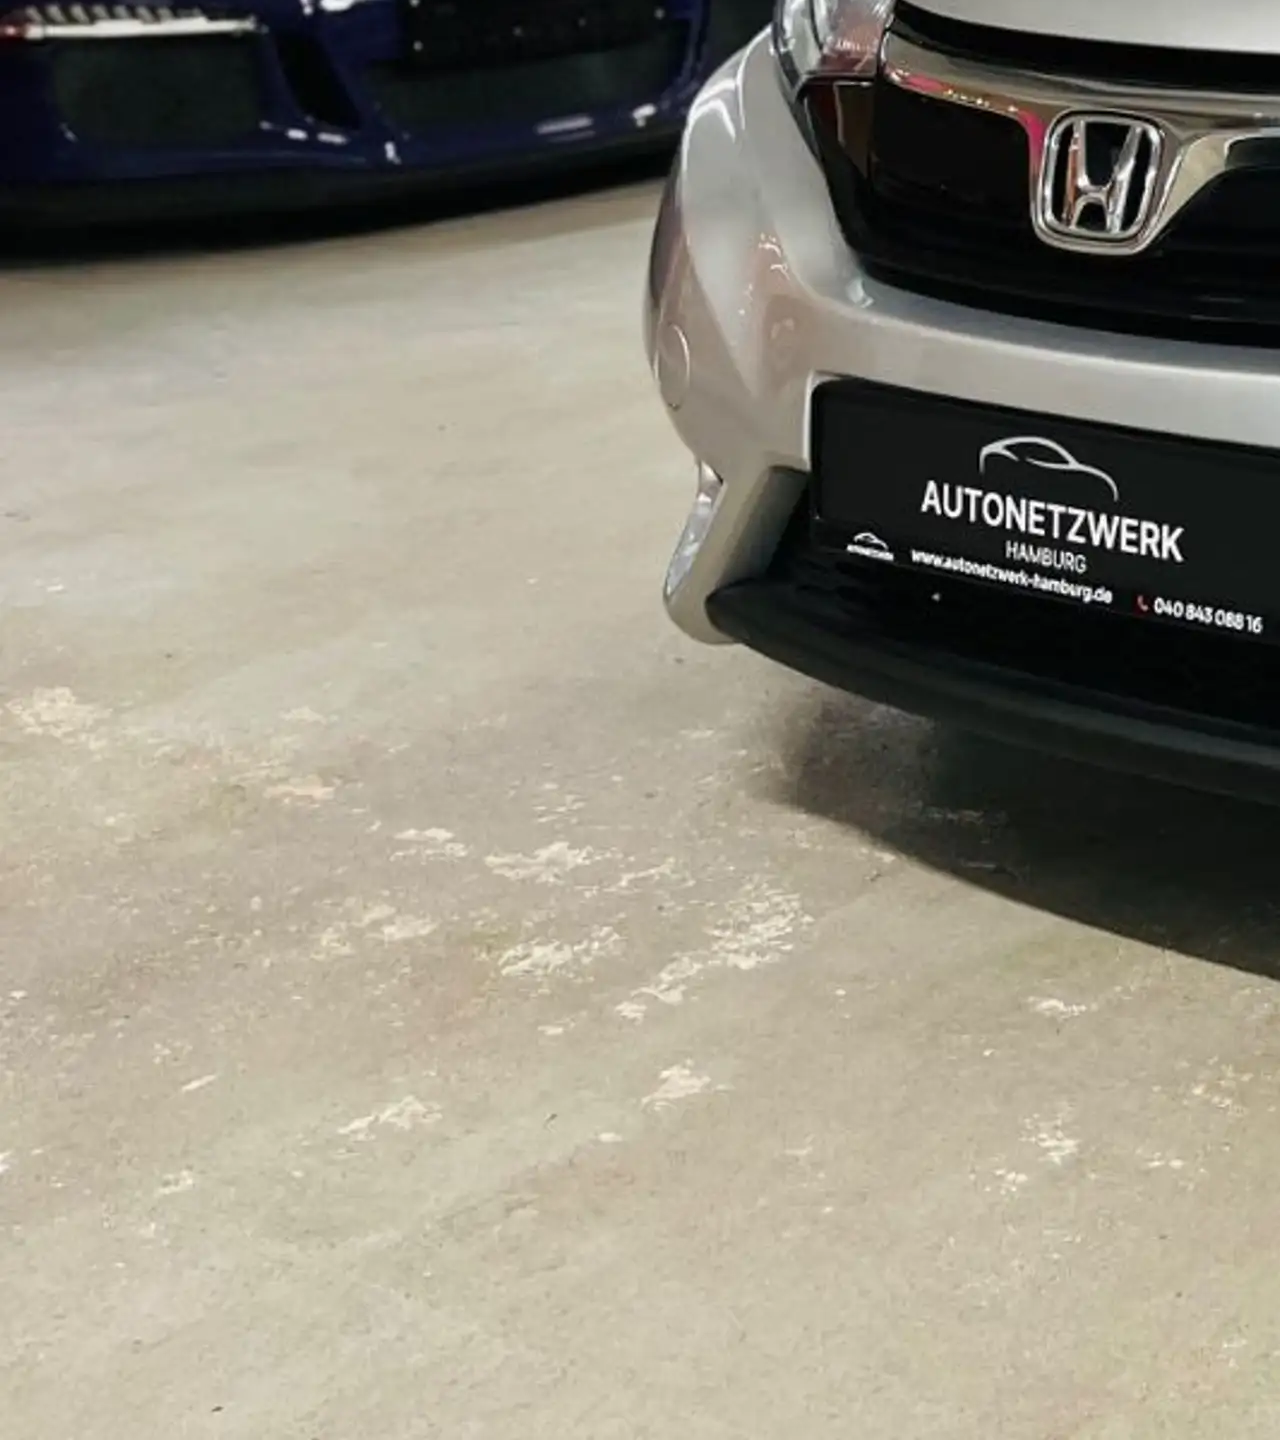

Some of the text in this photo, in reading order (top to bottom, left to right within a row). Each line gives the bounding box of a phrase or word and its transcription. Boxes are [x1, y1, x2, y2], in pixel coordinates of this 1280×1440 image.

[921, 479, 1184, 563] AUTONETZWERK
[1005, 539, 1087, 573] HAMBURG
[911, 549, 1113, 604] www.autonetzwerk-hamburg.de
[1153, 597, 1184, 619] 040
[1185, 603, 1213, 625] 843
[1214, 609, 1245, 632] 088
[1246, 615, 1264, 635] 16
